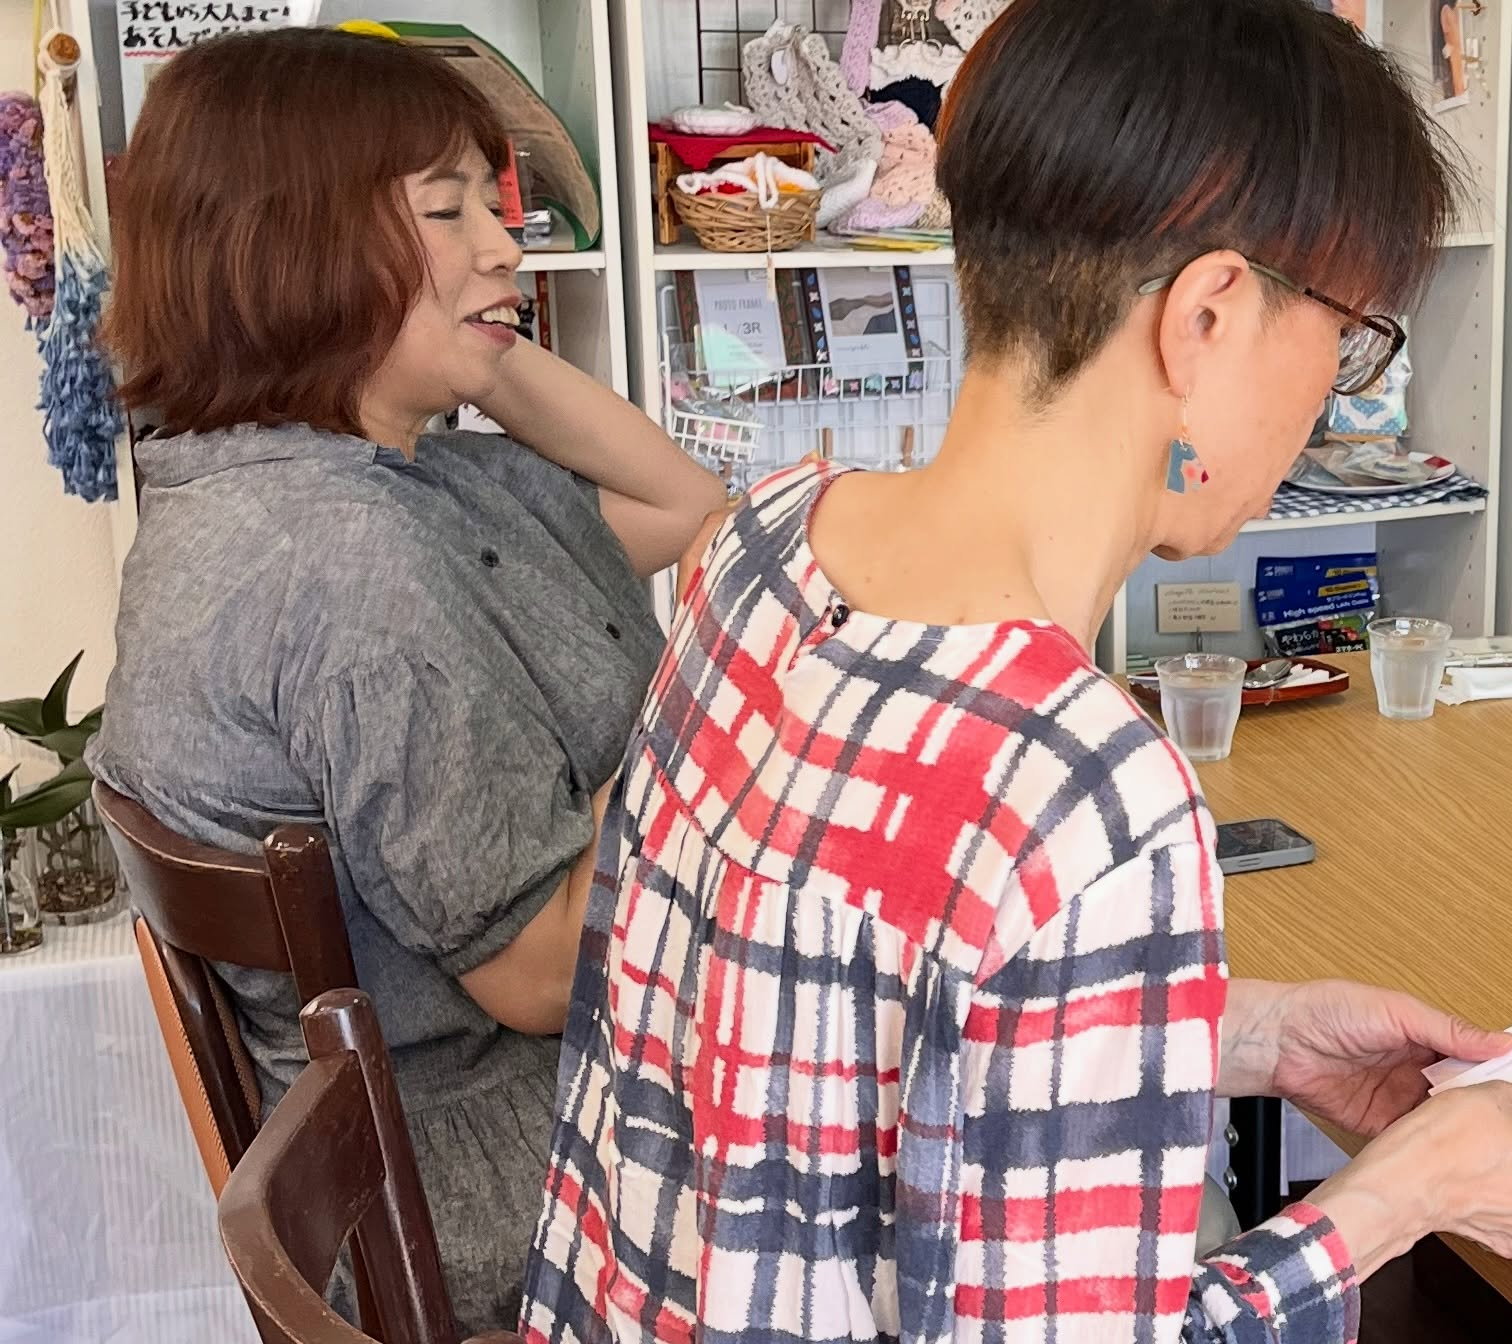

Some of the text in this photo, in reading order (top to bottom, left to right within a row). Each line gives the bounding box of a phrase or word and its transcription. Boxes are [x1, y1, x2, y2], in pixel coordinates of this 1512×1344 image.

[120, 0, 290, 23] 子どもから大人まで
[1283, 607, 1306, 619] High
[1307, 602, 1335, 614] speed
